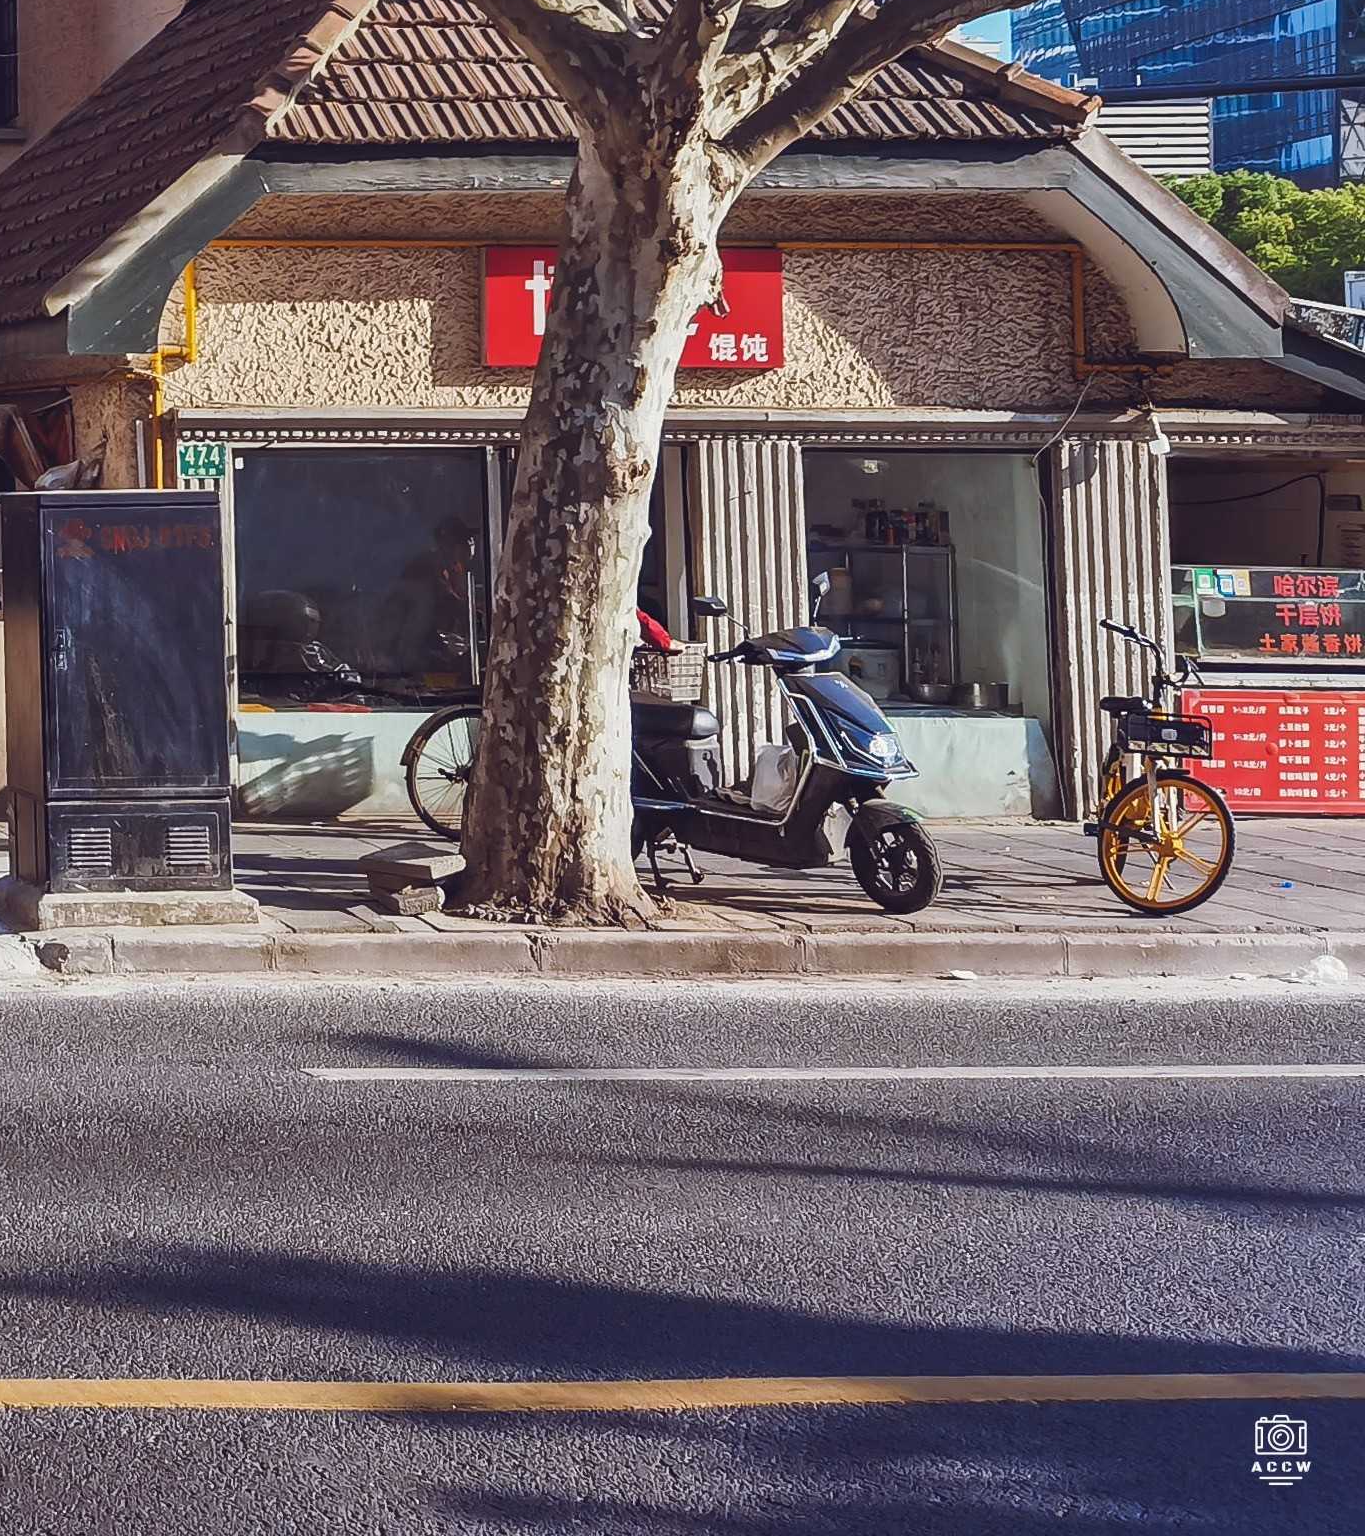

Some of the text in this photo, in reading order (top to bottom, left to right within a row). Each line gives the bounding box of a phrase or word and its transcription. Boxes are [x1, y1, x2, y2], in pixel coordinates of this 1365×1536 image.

[708, 333, 769, 362] 馄饨
[184, 446, 220, 465] 474
[1273, 574, 1340, 597] 哈尔滨
[1275, 603, 1342, 626] 千层饼
[1258, 633, 1362, 654] 土家酱香饼
